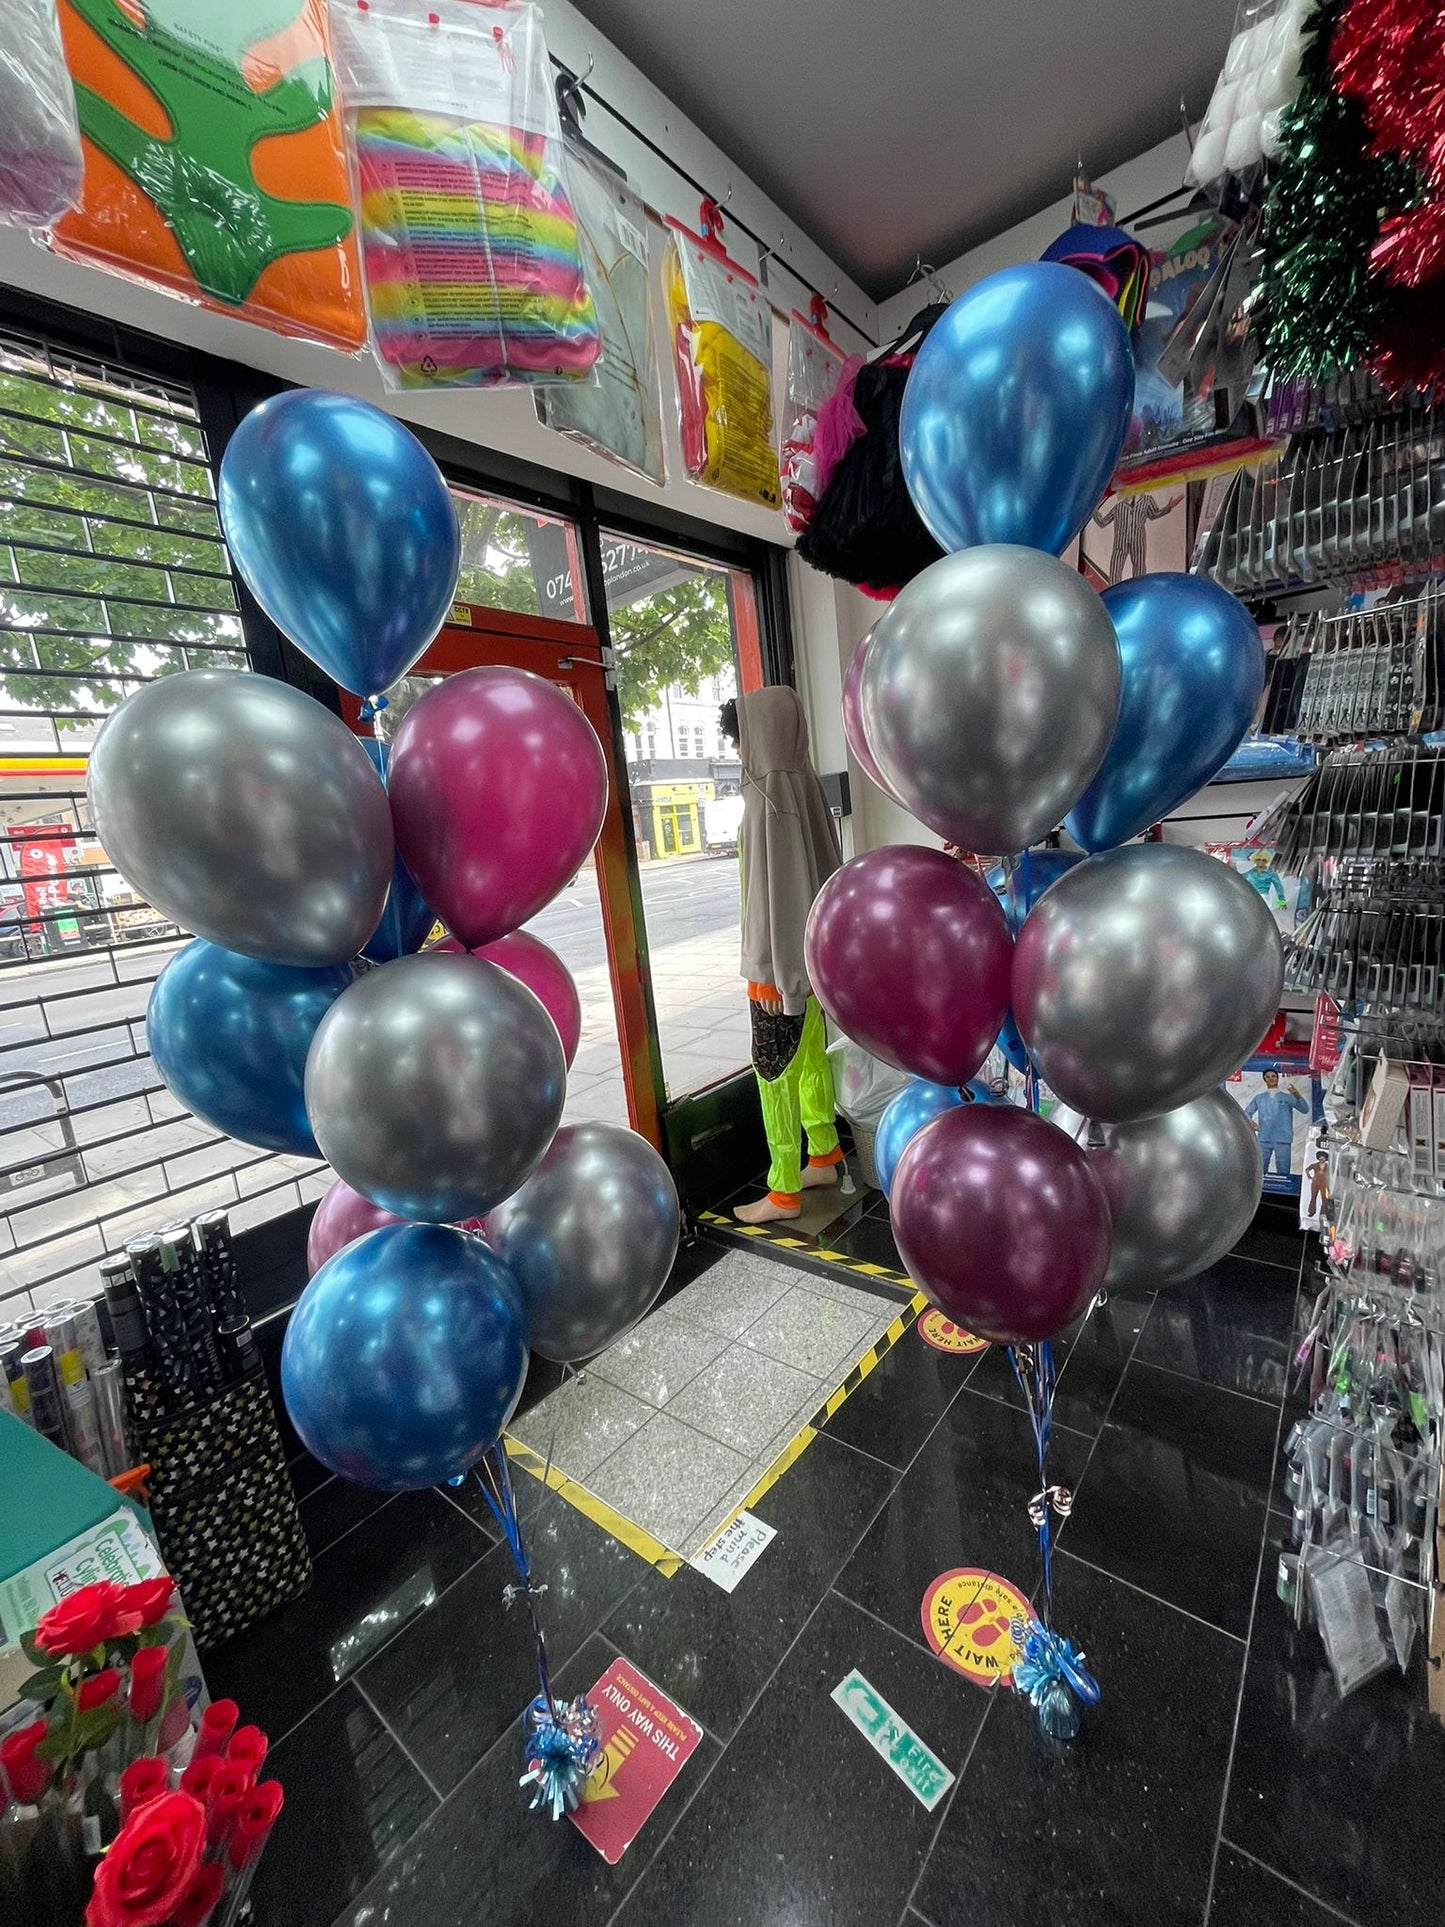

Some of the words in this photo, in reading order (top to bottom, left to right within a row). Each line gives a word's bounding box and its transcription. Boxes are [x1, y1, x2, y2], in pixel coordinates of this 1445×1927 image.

[928, 1328, 953, 1346] HERE
[724, 1518, 746, 1538] the
[704, 1537, 726, 1562] step
[720, 1530, 748, 1563] mind
[730, 1528, 767, 1568] Please
[957, 1580, 994, 1592] distance
[995, 1586, 1012, 1605] safe
[937, 1595, 954, 1641] HERE
[953, 1645, 999, 1668] WAIT
[601, 1683, 631, 1712] ONLY
[616, 1674, 640, 1699] DISTANCE
[627, 1708, 654, 1737] WAY
[651, 1729, 680, 1762] THIS
[901, 1758, 931, 1793] exit
[908, 1745, 941, 1781] Fire
